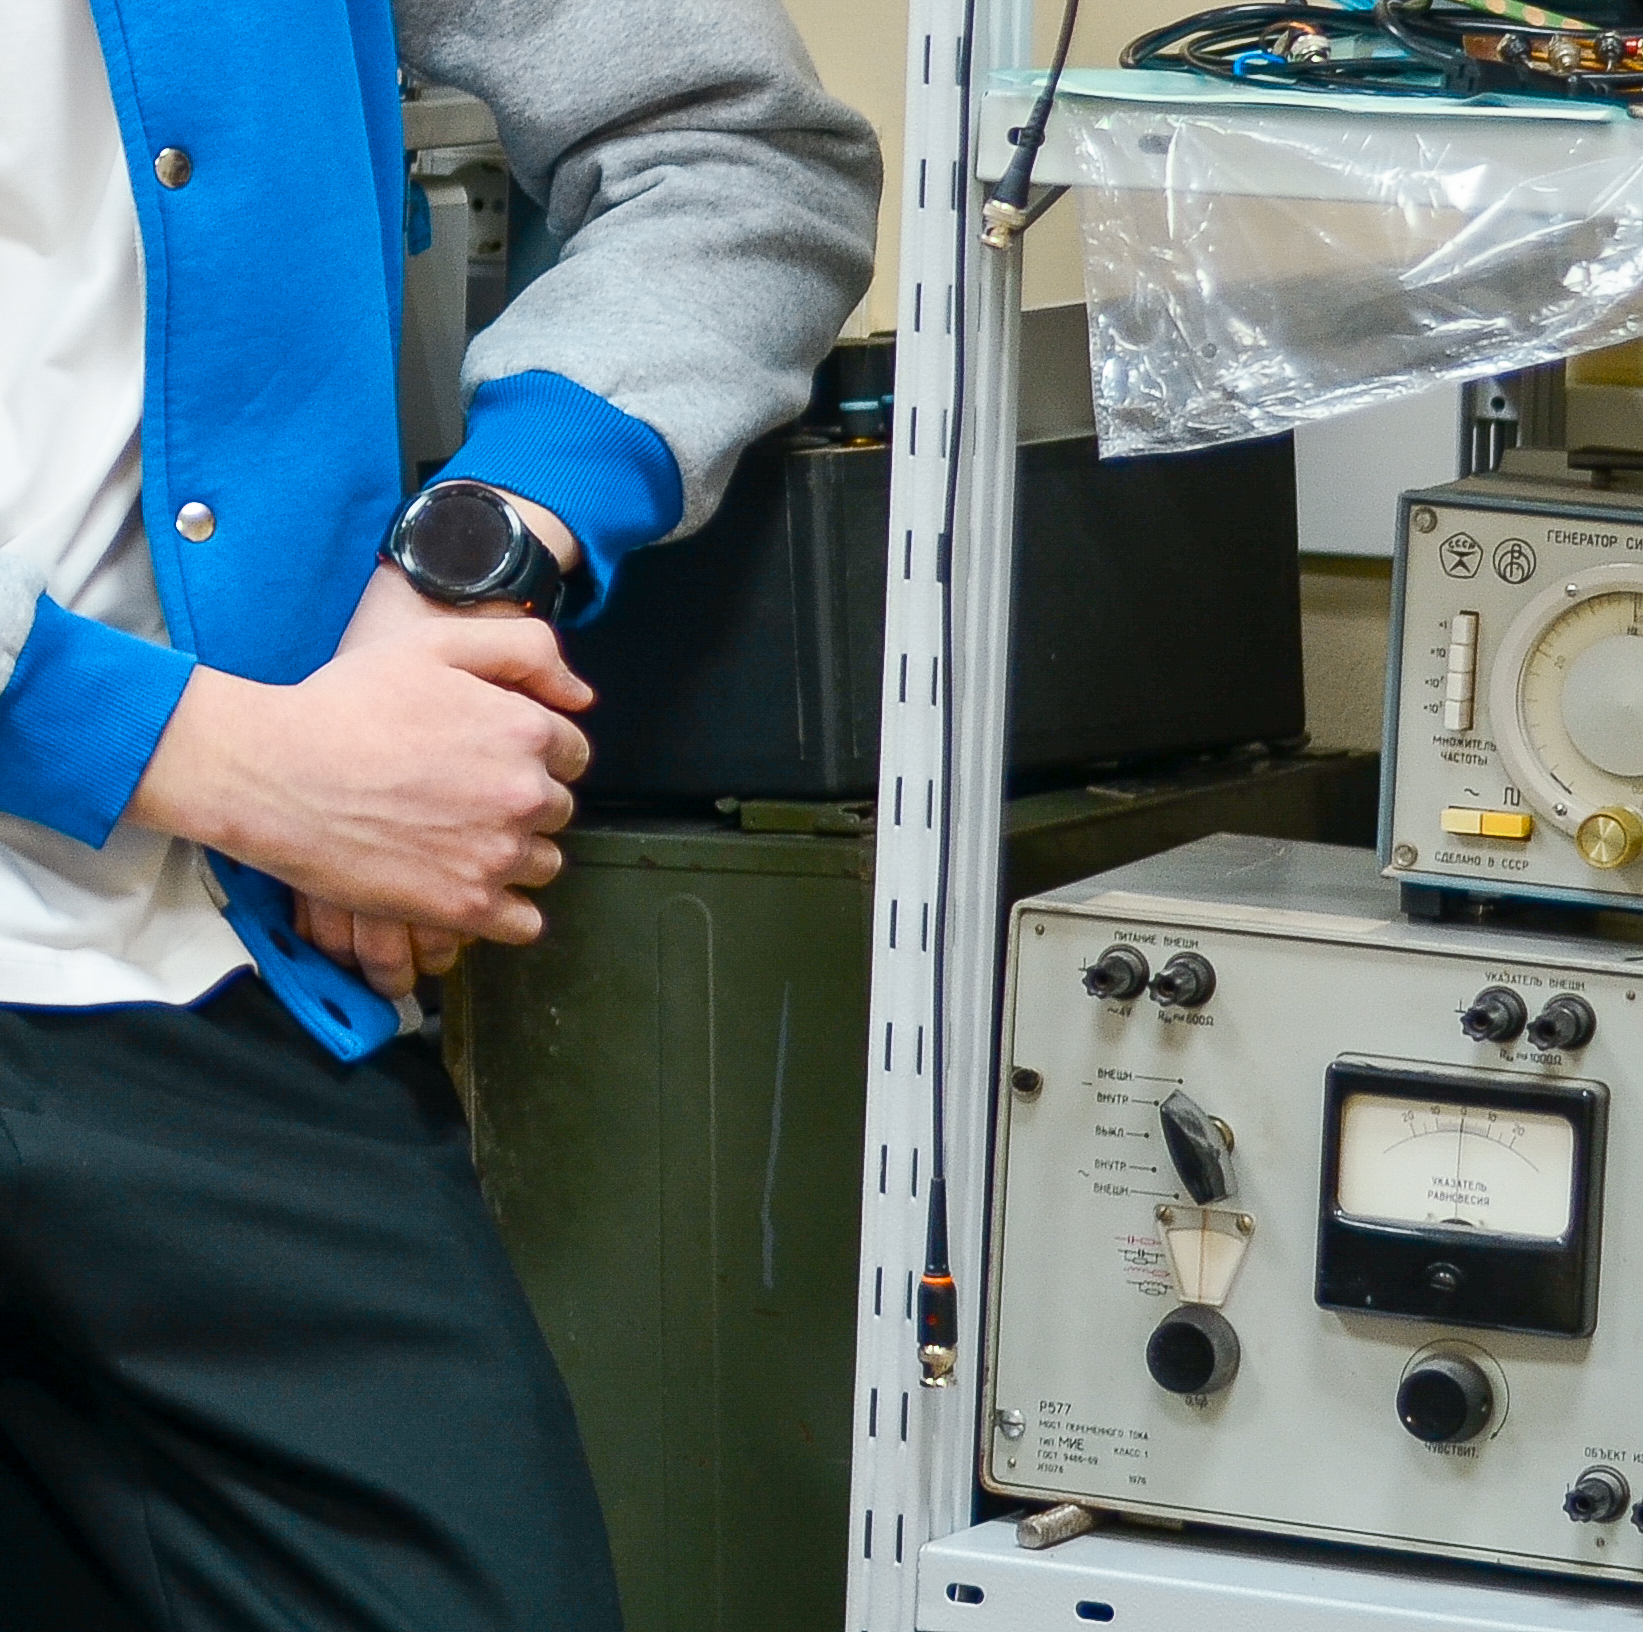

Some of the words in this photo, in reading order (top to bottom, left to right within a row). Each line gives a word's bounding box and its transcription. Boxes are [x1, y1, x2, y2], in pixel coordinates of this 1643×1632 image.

[1546, 529, 1618, 548] ГЕНЕРАТОР
[1432, 735, 1497, 752] МНОЖИТЕЛЬ
[1440, 751, 1488, 766] ЧАСТОТЫ
[1434, 851, 1482, 867] СДЕЛАНО
[1487, 856, 1495, 868] В
[1501, 857, 1530, 871] СССР
[1114, 930, 1157, 946] ПИТАНИЕ
[1484, 970, 1543, 988] УКАЗАТЕЛЬ
[1095, 1124, 1124, 1138] ВЫКЛ
[1431, 1176, 1487, 1192] УКАЗАТЕЛЬ
[1427, 1190, 1491, 1206] РАВНОВЕСИЯ
[1038, 1419, 1062, 1430] МОСТ
[1065, 1421, 1125, 1438] ПЕРЕМЕННОГО
[1128, 1429, 1149, 1440] ТОКА
[1037, 1449, 1059, 1460] ГОСТ
[1113, 1447, 1142, 1458] КЛАСС
[1584, 1446, 1627, 1462] ОБЪЕКТ
